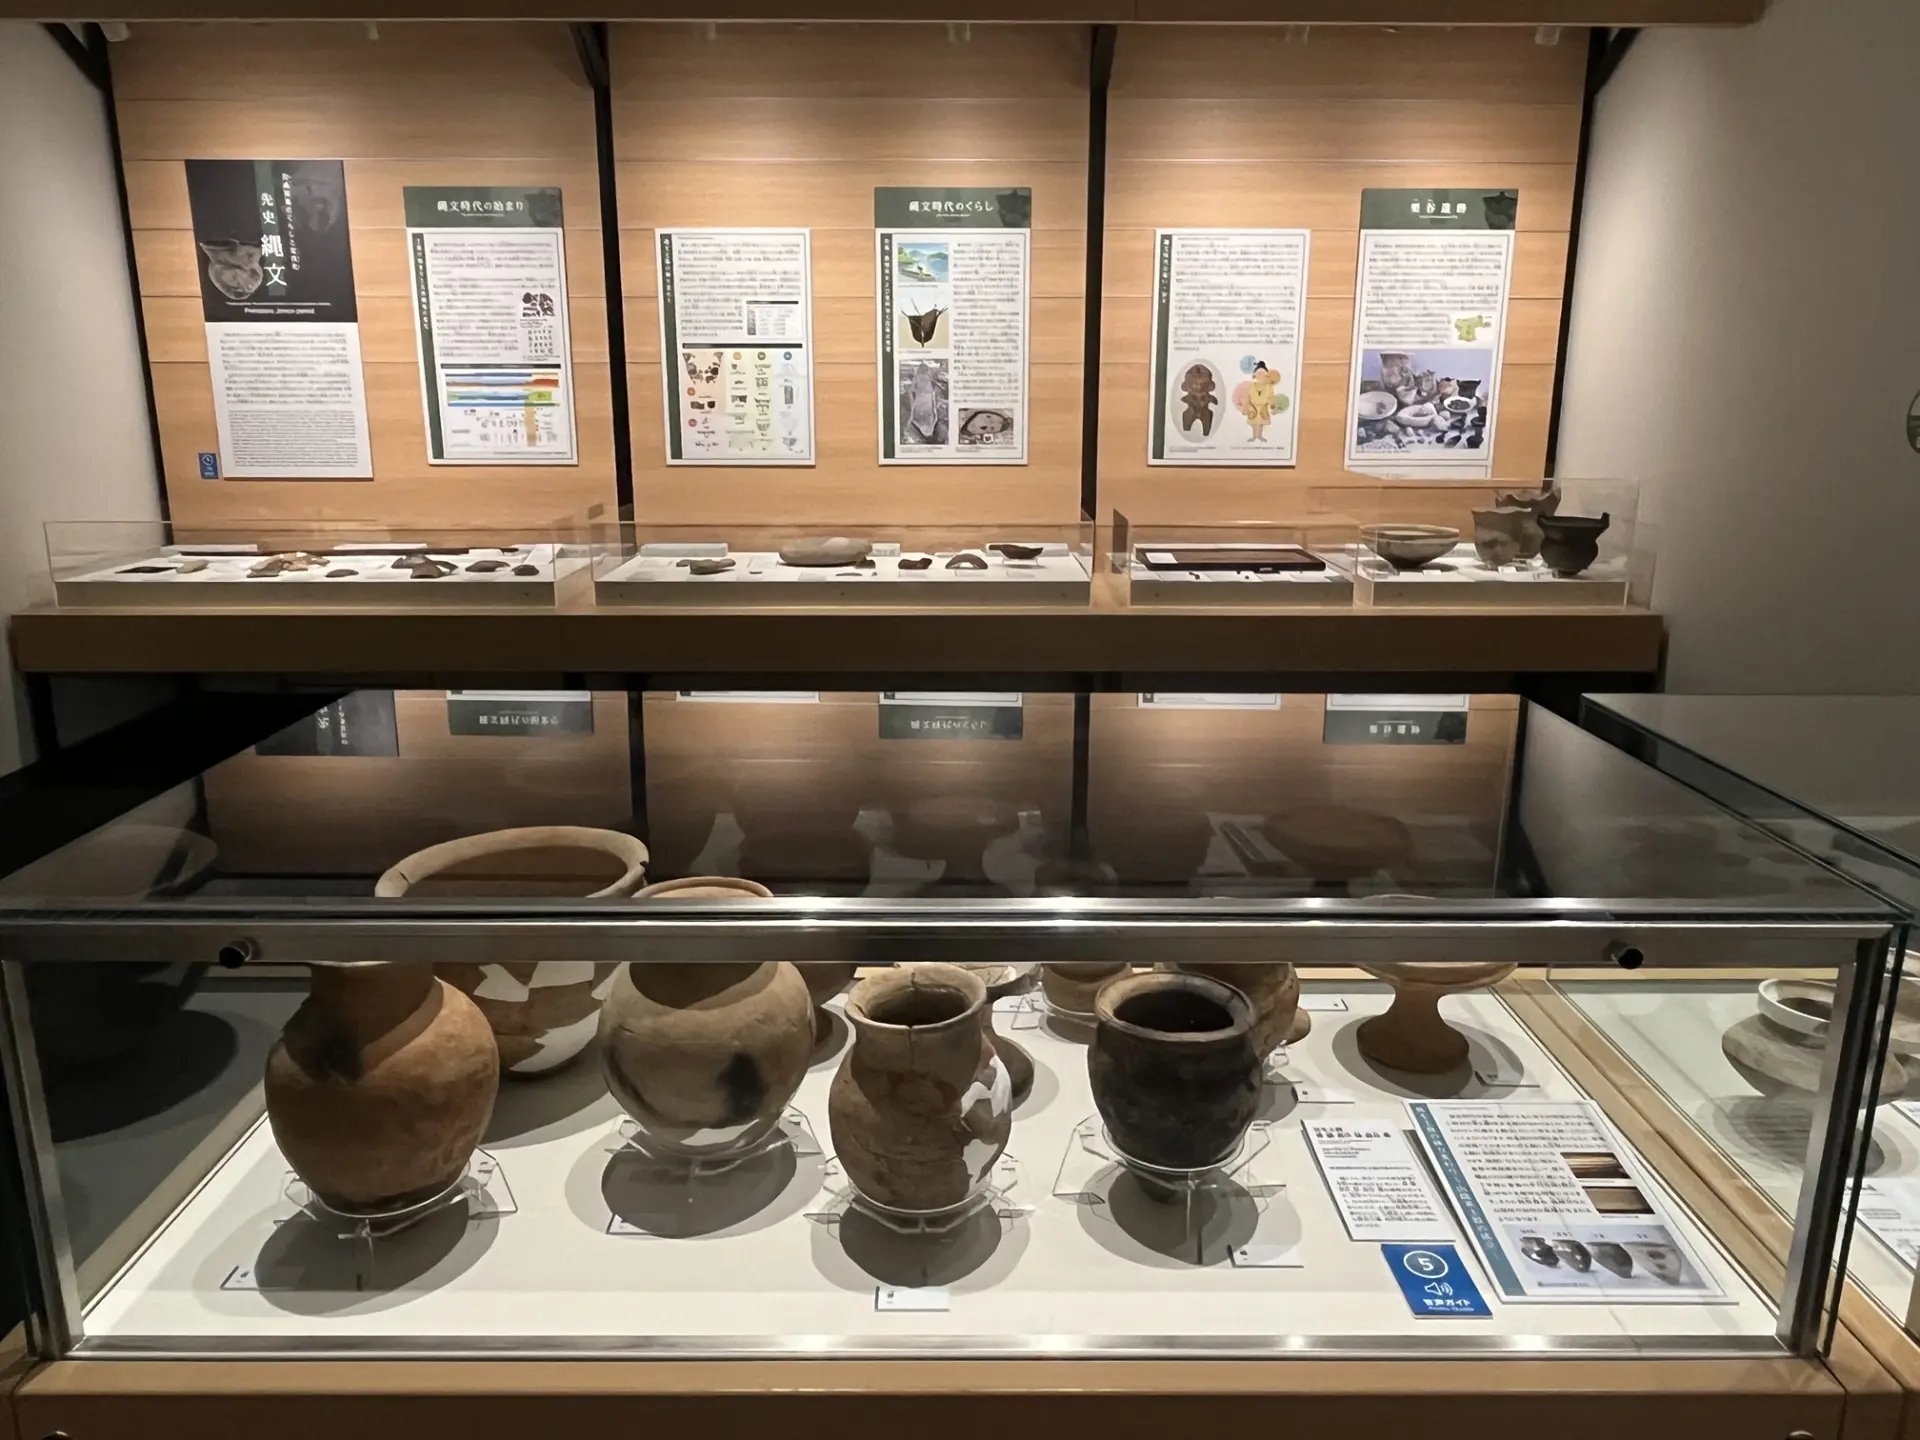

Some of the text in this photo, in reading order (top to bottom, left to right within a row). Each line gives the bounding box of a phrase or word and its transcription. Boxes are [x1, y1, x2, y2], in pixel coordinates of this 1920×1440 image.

[437, 200, 524, 212] 縄文時代の始まり
[909, 200, 994, 212] 縄文時代のくらし
[1417, 1257, 1435, 1271] 5
[1422, 1298, 1471, 1306] 音声ガイド
